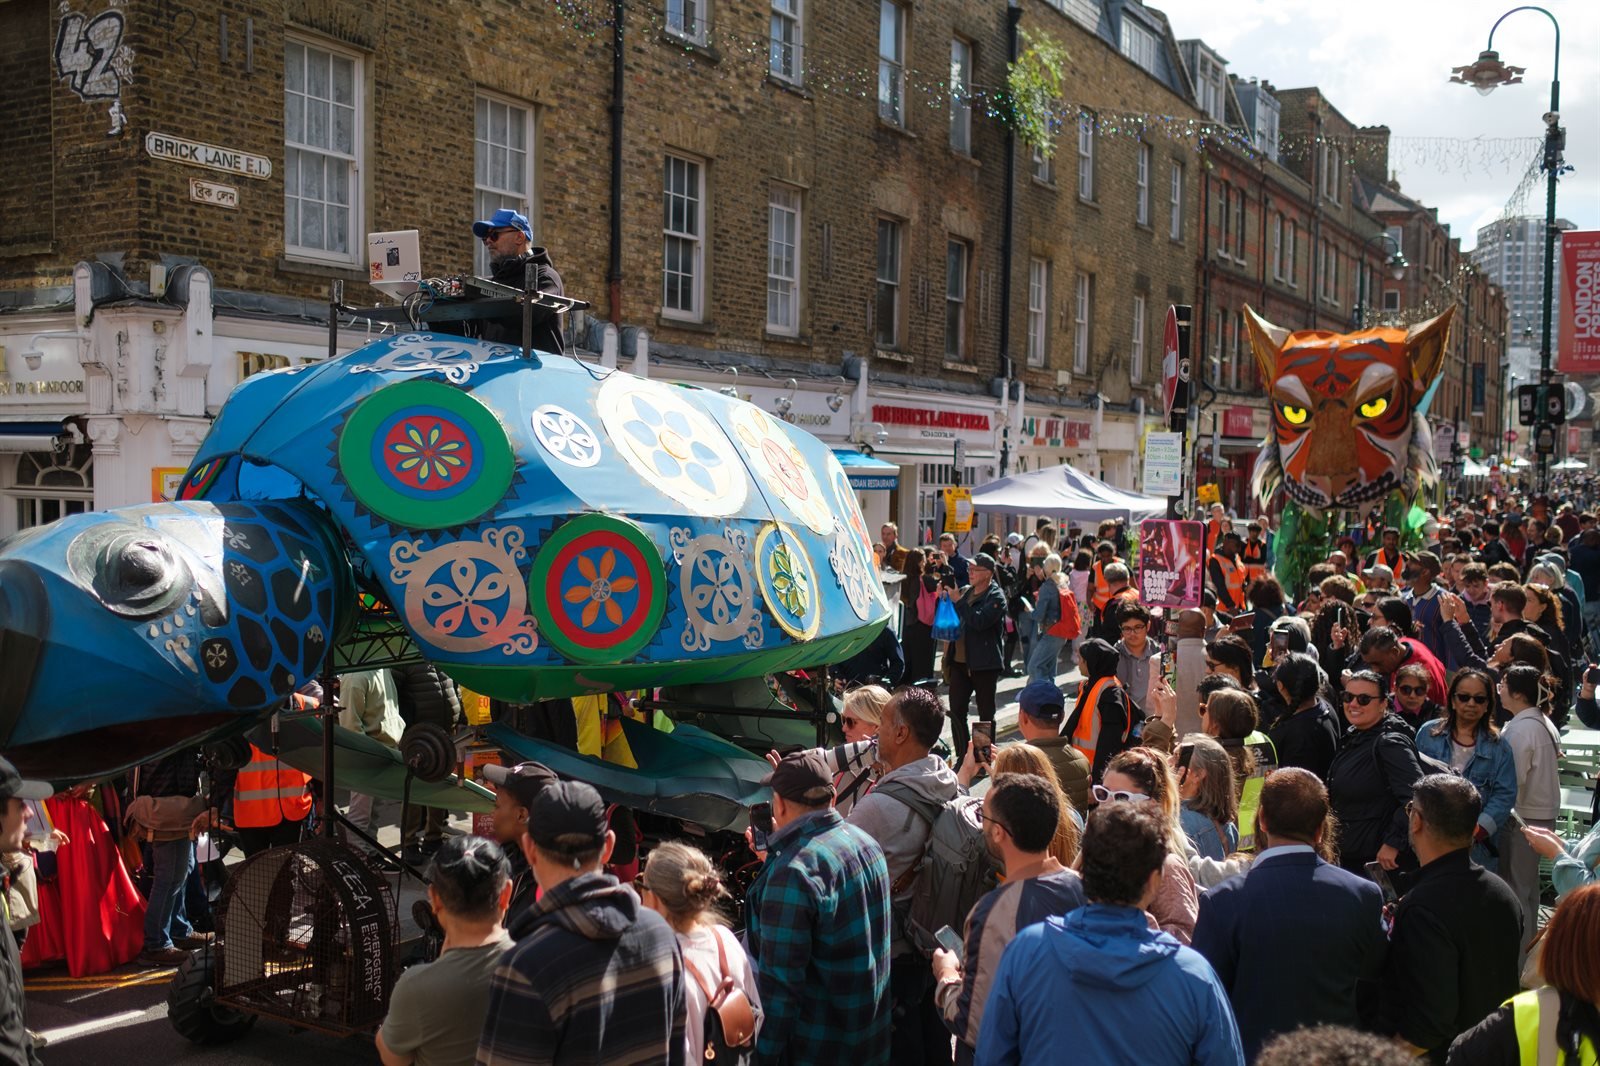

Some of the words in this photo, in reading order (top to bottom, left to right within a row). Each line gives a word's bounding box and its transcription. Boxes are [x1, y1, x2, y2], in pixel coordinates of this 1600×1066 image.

[154, 138, 200, 161] BRICK
[205, 145, 241, 170] LANE
[1575, 262, 1593, 338] LONDON
[892, 406, 930, 426] BRICK
[960, 413, 990, 431] PIZZA
[868, 479, 896, 488] RESTAURANT
[361, 924, 372, 953] EXIT
[364, 957, 373, 992] ARTS
[370, 922, 382, 1002] EMERGENCY
